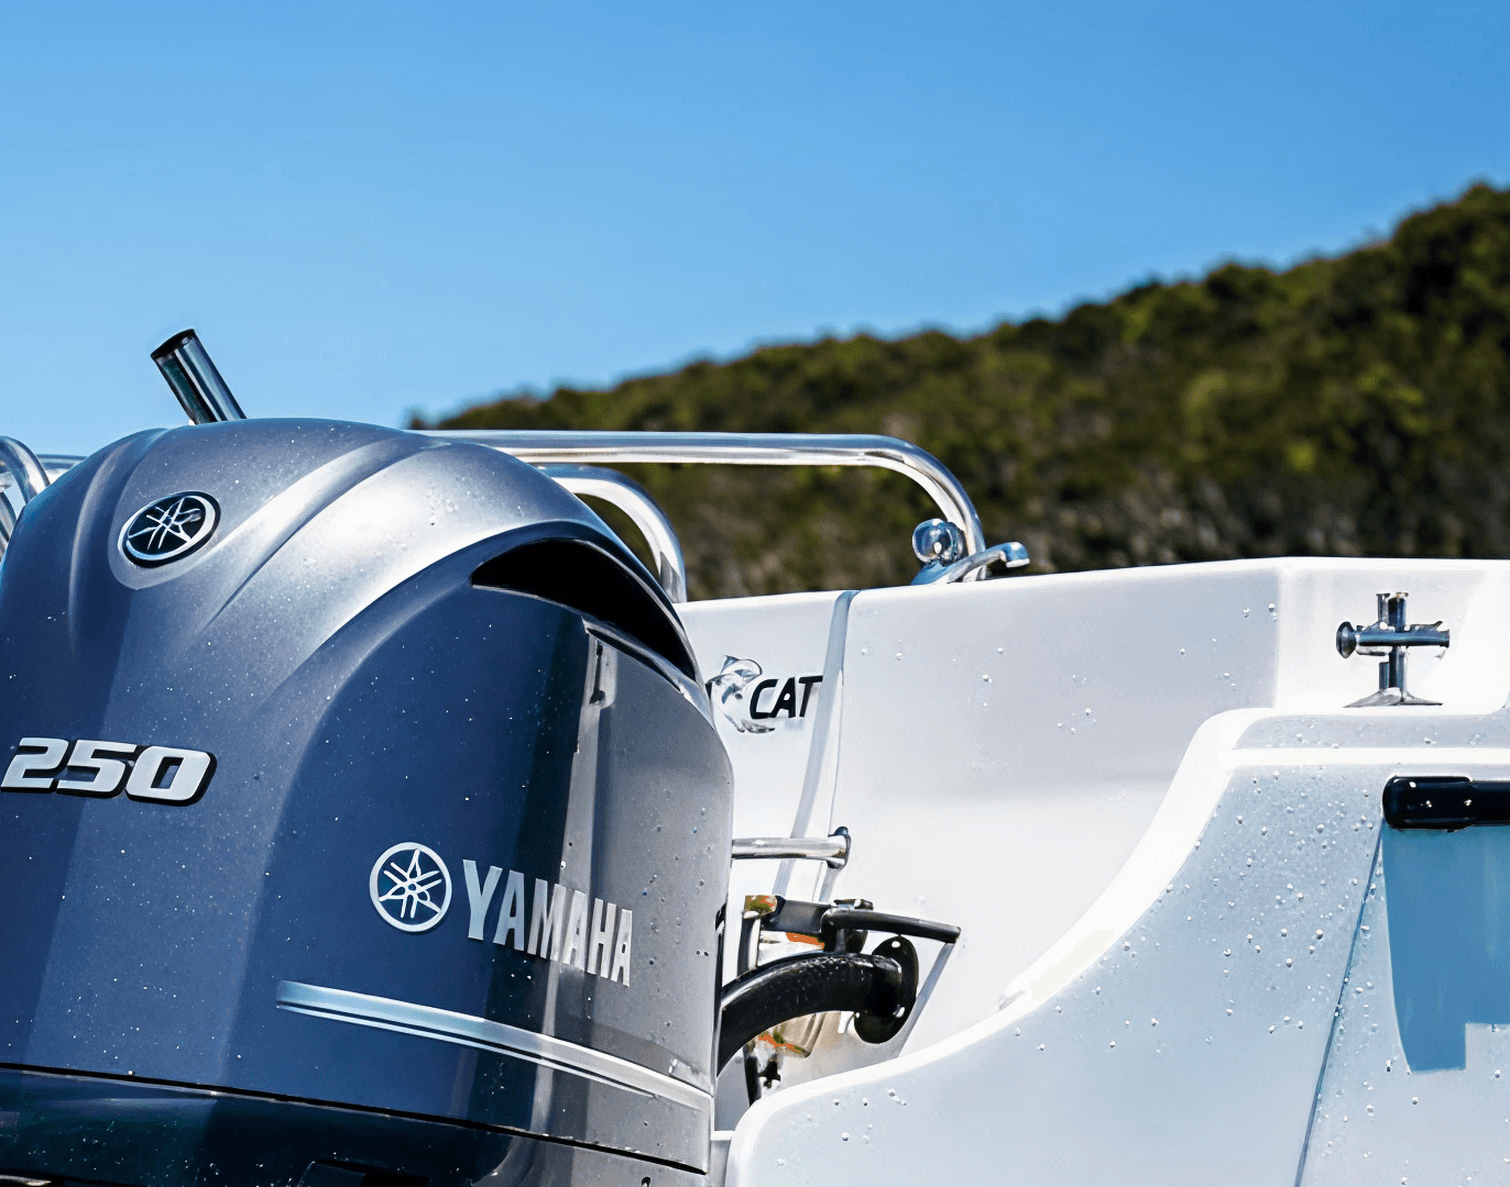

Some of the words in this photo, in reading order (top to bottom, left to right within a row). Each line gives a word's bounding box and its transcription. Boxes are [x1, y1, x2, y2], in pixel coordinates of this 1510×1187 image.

[749, 675, 824, 720] CAT
[0, 737, 217, 807] 250
[462, 858, 633, 988] YAMAHA
